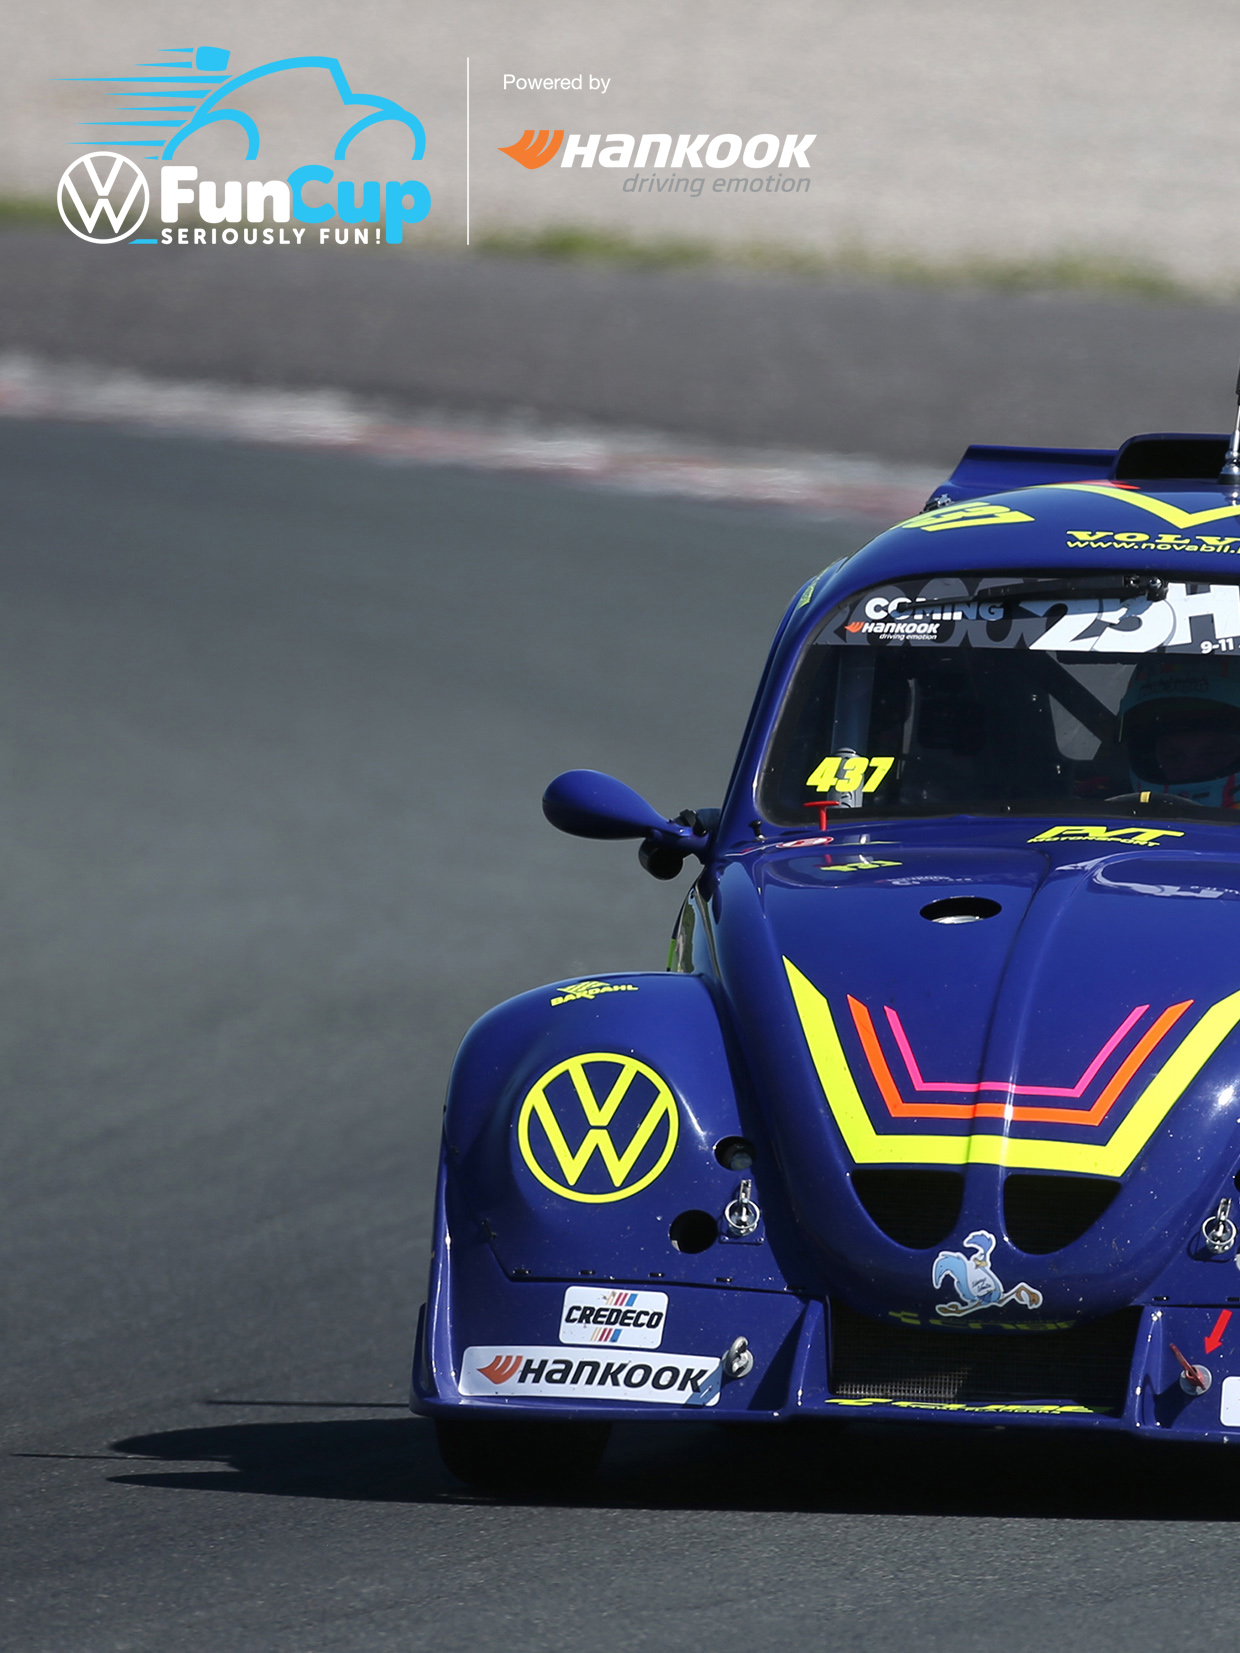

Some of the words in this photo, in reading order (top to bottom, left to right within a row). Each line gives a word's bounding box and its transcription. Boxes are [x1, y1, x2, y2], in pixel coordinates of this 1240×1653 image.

[865, 597, 1004, 621] COMING
[1200, 639, 1234, 655] 9-11
[806, 757, 895, 793] 437
[550, 984, 640, 1007] BARDAHL
[564, 1305, 664, 1329] CREDECO
